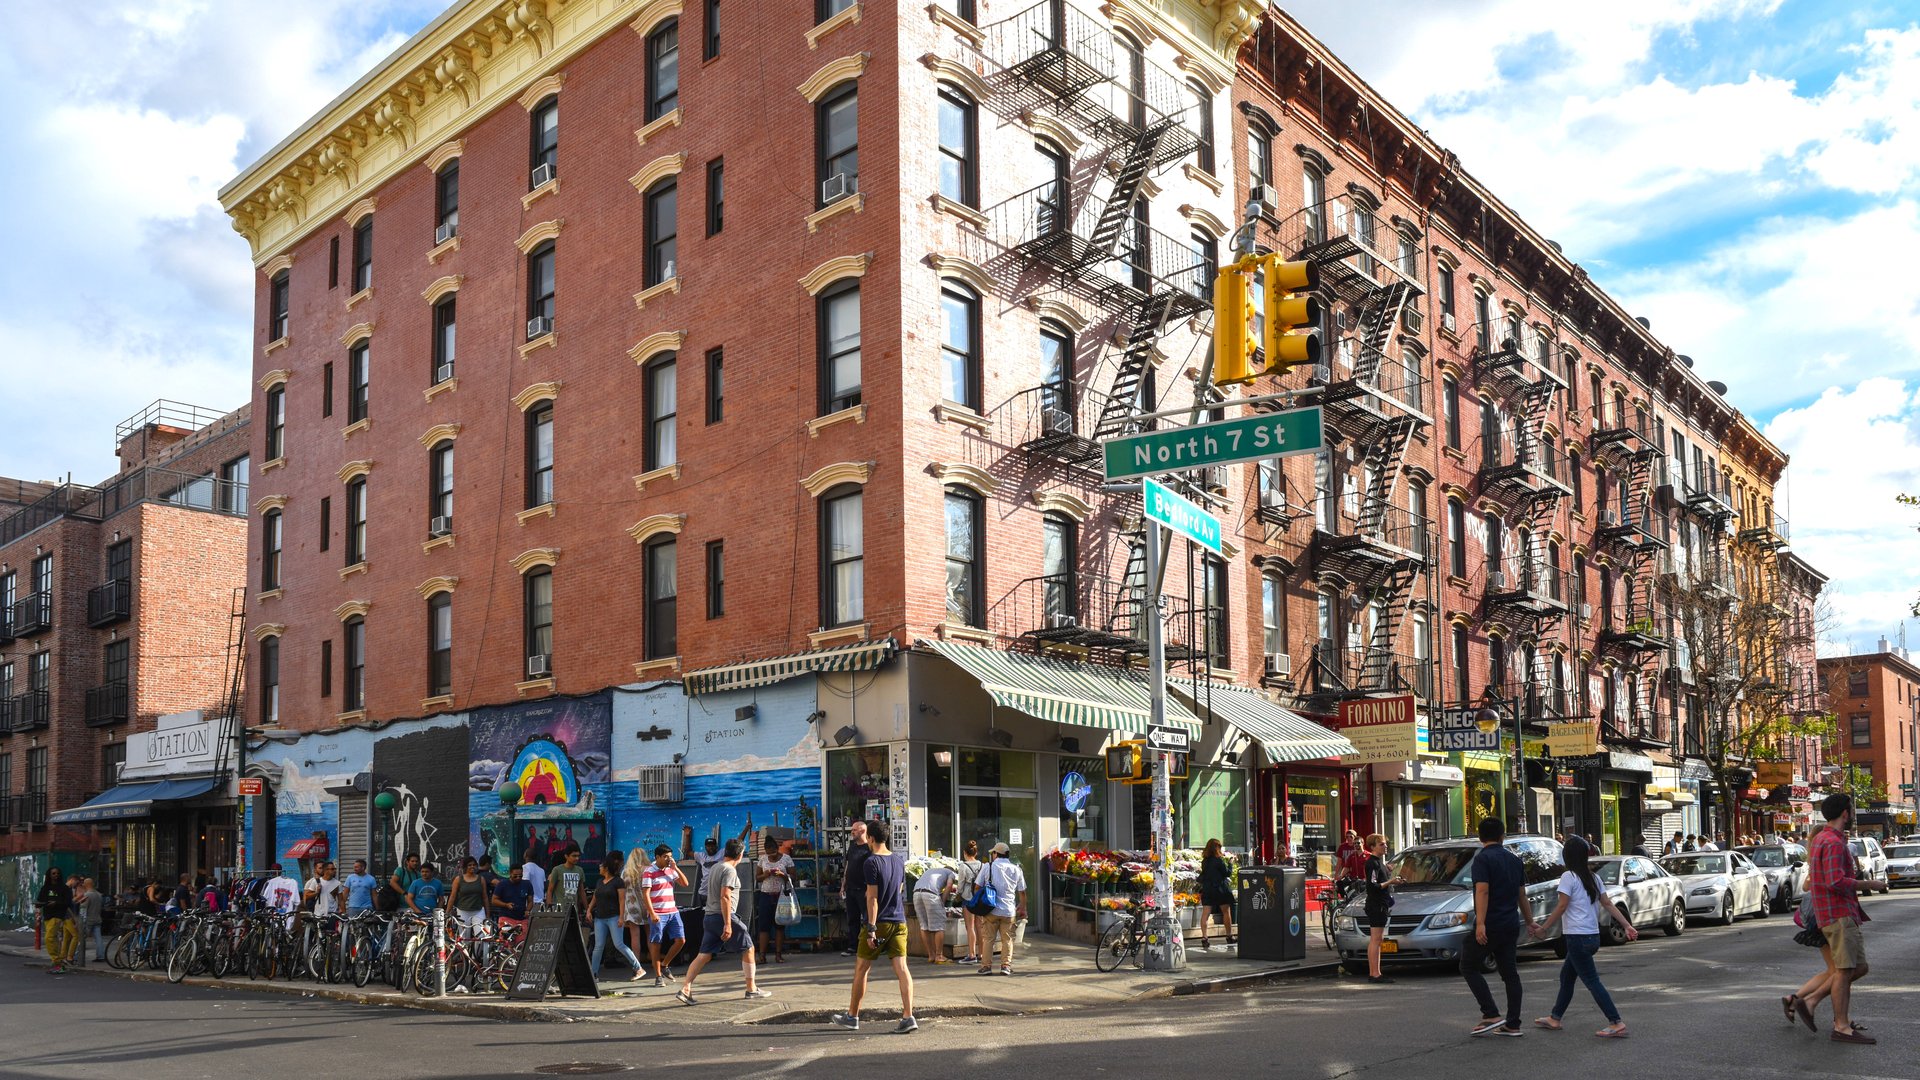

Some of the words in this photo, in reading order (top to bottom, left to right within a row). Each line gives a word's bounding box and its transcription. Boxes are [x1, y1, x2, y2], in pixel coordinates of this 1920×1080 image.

[1135, 433, 1218, 466] North
[1226, 429, 1243, 451] 7
[1253, 423, 1286, 448] St
[1155, 492, 1199, 533] Bedford
[1202, 519, 1214, 542] Av
[1347, 700, 1406, 725] FORNINO
[1431, 711, 1477, 728] CHEC
[705, 729, 745, 743] STATION
[1153, 732, 1166, 742] ONE
[1171, 734, 1184, 744] WAY
[1431, 732, 1497, 750] CASHED
[149, 729, 207, 760] STATION
[1347, 753, 1360, 761] 718
[1366, 750, 1410, 760] 384-6004
[1304, 806, 1325, 822] FORNINO
[292, 843, 312, 852] ATM
[1292, 845, 1296, 853] A
[534, 942, 550, 952] BEST
